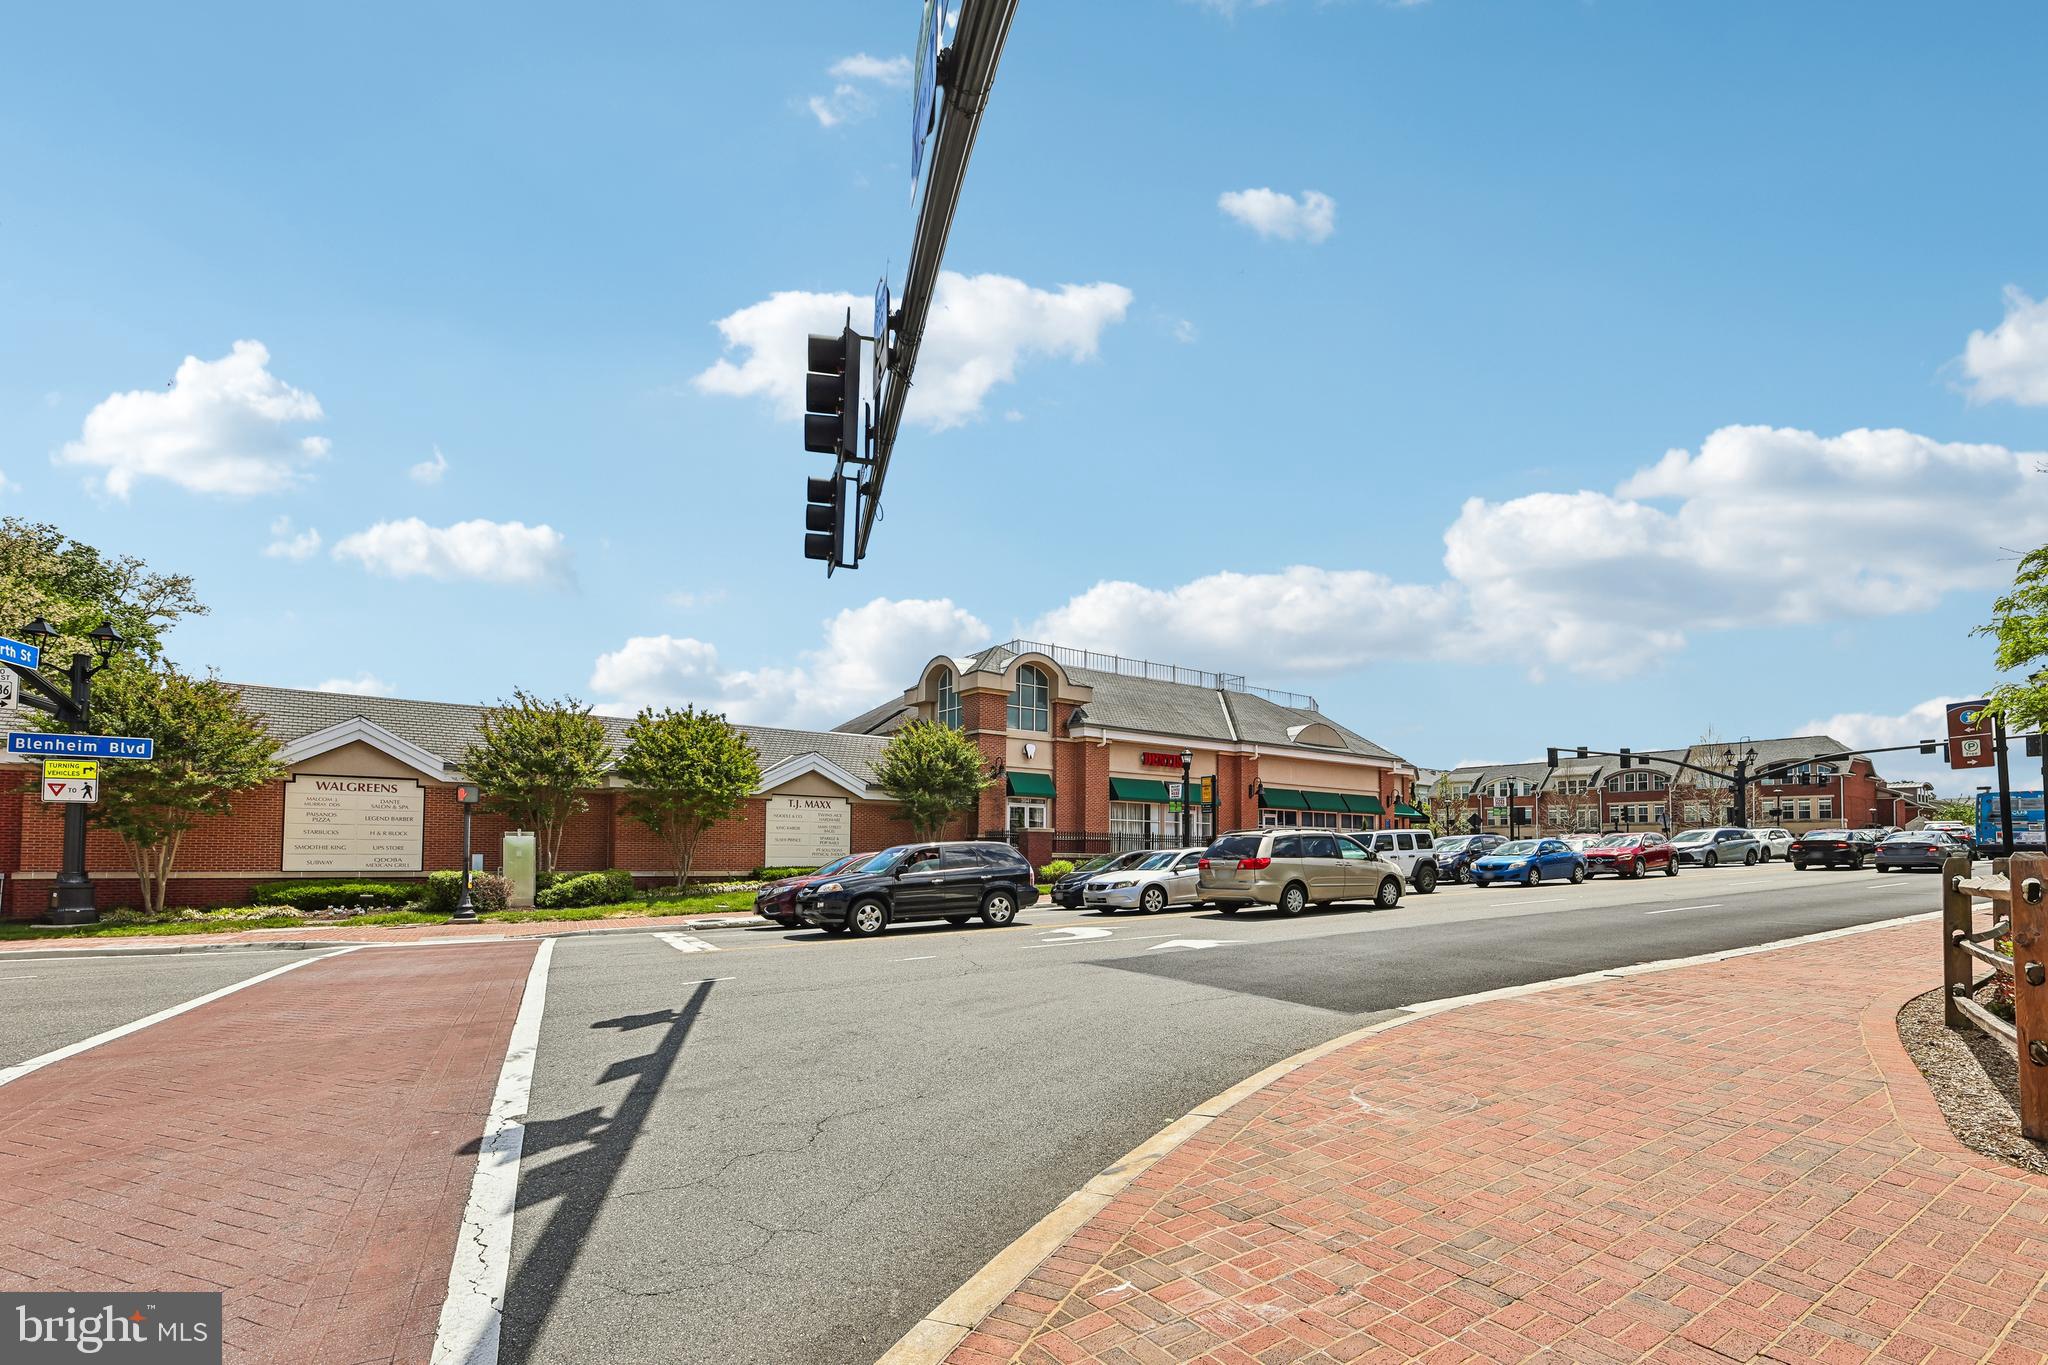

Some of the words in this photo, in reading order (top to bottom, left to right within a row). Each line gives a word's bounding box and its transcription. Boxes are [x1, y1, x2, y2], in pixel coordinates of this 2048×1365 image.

[0, 645, 16, 659] rth
[20, 649, 32, 662] St
[15, 737, 97, 753] Blenheim
[109, 742, 146, 755] Blvd
[1143, 752, 1182, 768] DENTIS
[315, 781, 398, 794] WALGREENS
[788, 799, 802, 810] T.J.
[805, 800, 831, 809] MAXX
